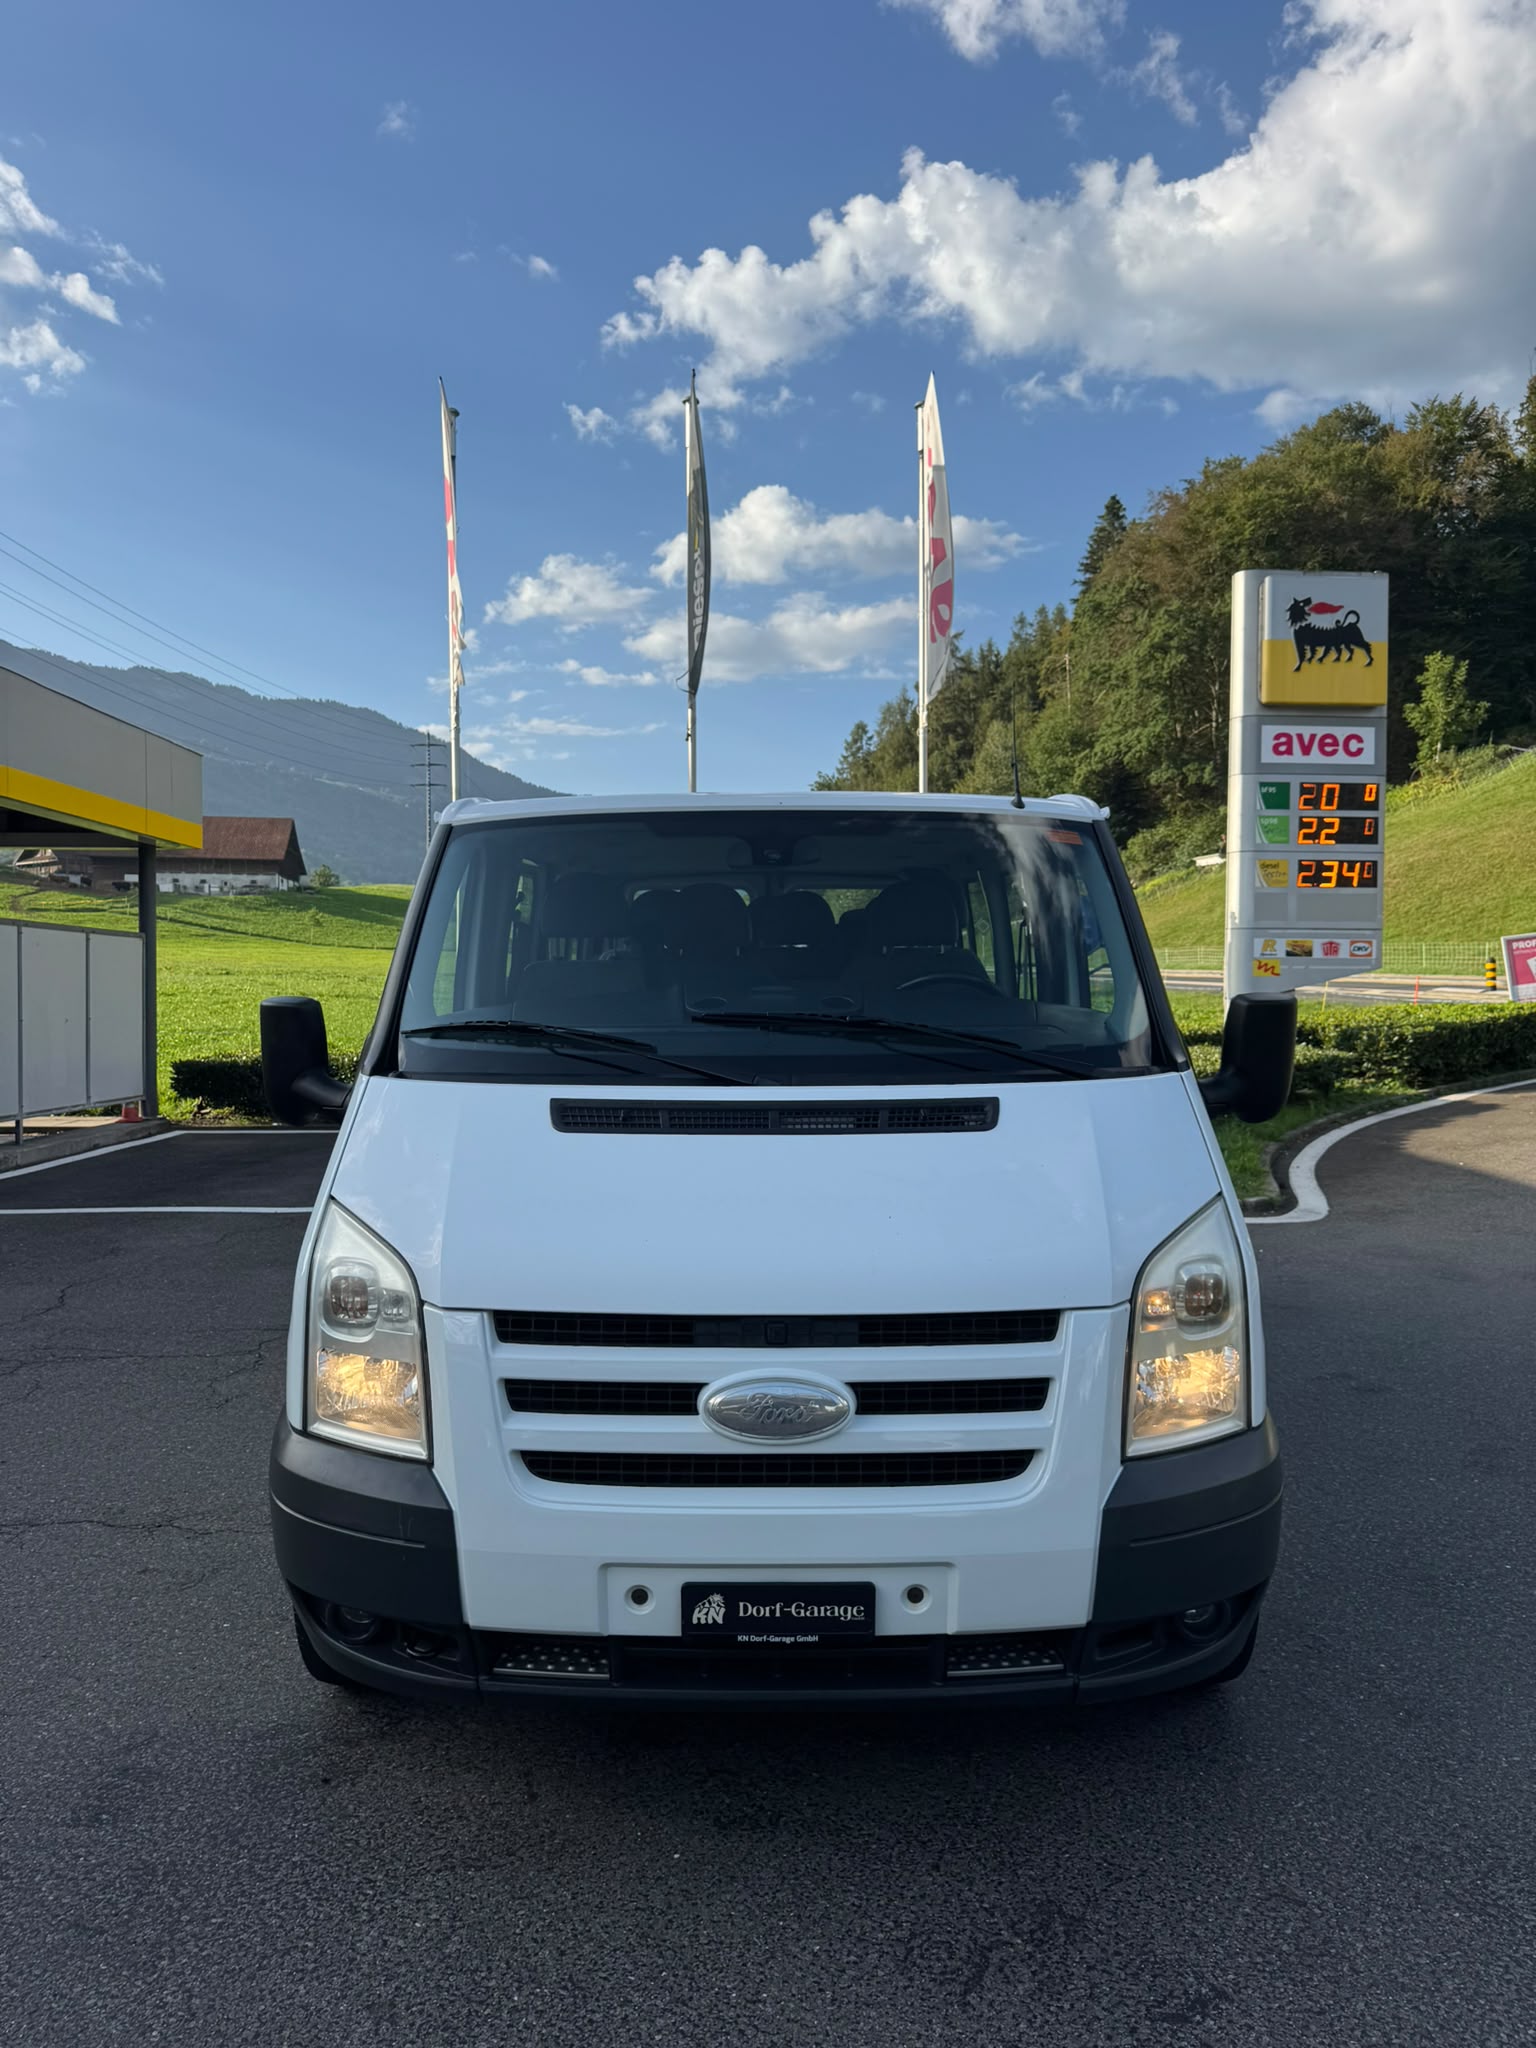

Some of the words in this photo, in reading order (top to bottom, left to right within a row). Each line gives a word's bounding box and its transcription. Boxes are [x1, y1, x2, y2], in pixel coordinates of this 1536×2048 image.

[1272, 732, 1364, 757] avec
[738, 1393, 820, 1425] Ford
[738, 1602, 865, 1622] Dorf-Garage
[750, 1634, 795, 1644] Dorf-Garage
[796, 1634, 819, 1642] GmbH
